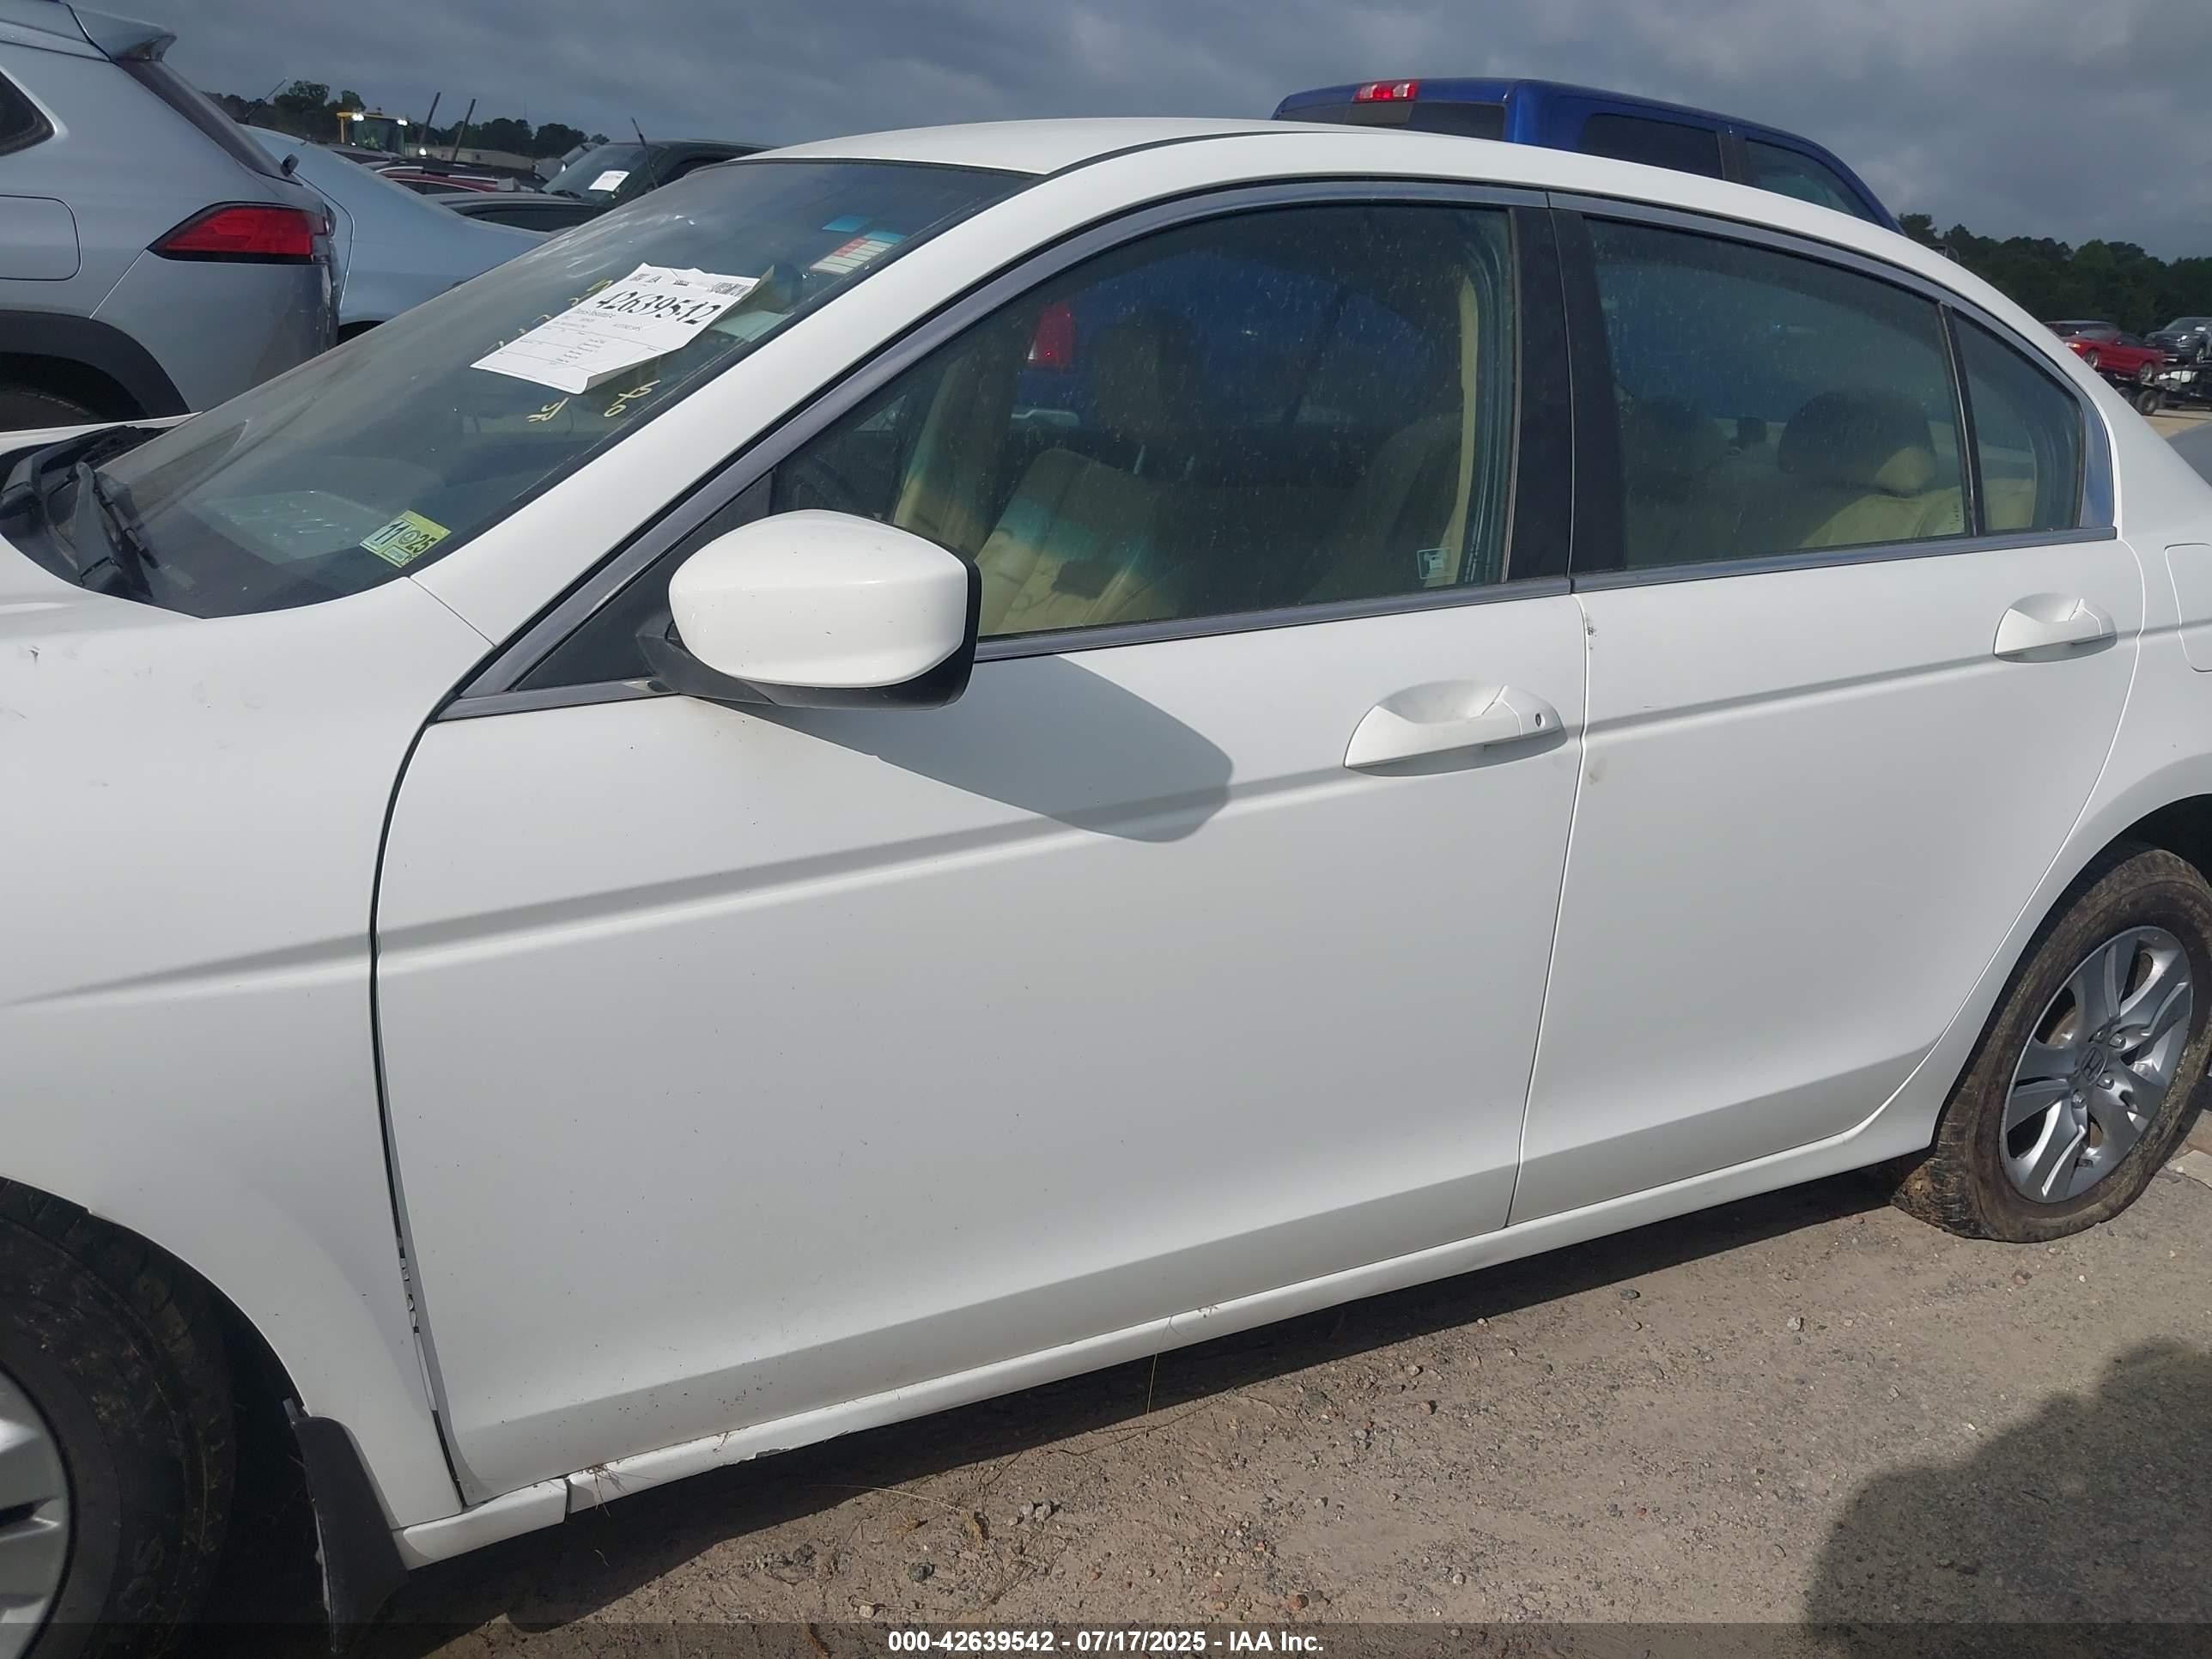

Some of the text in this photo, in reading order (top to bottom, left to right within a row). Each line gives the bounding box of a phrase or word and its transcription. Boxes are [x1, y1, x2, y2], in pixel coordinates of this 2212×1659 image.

[597, 290, 721, 325] 42639542
[374, 521, 410, 545] 11
[405, 533, 438, 554] 25
